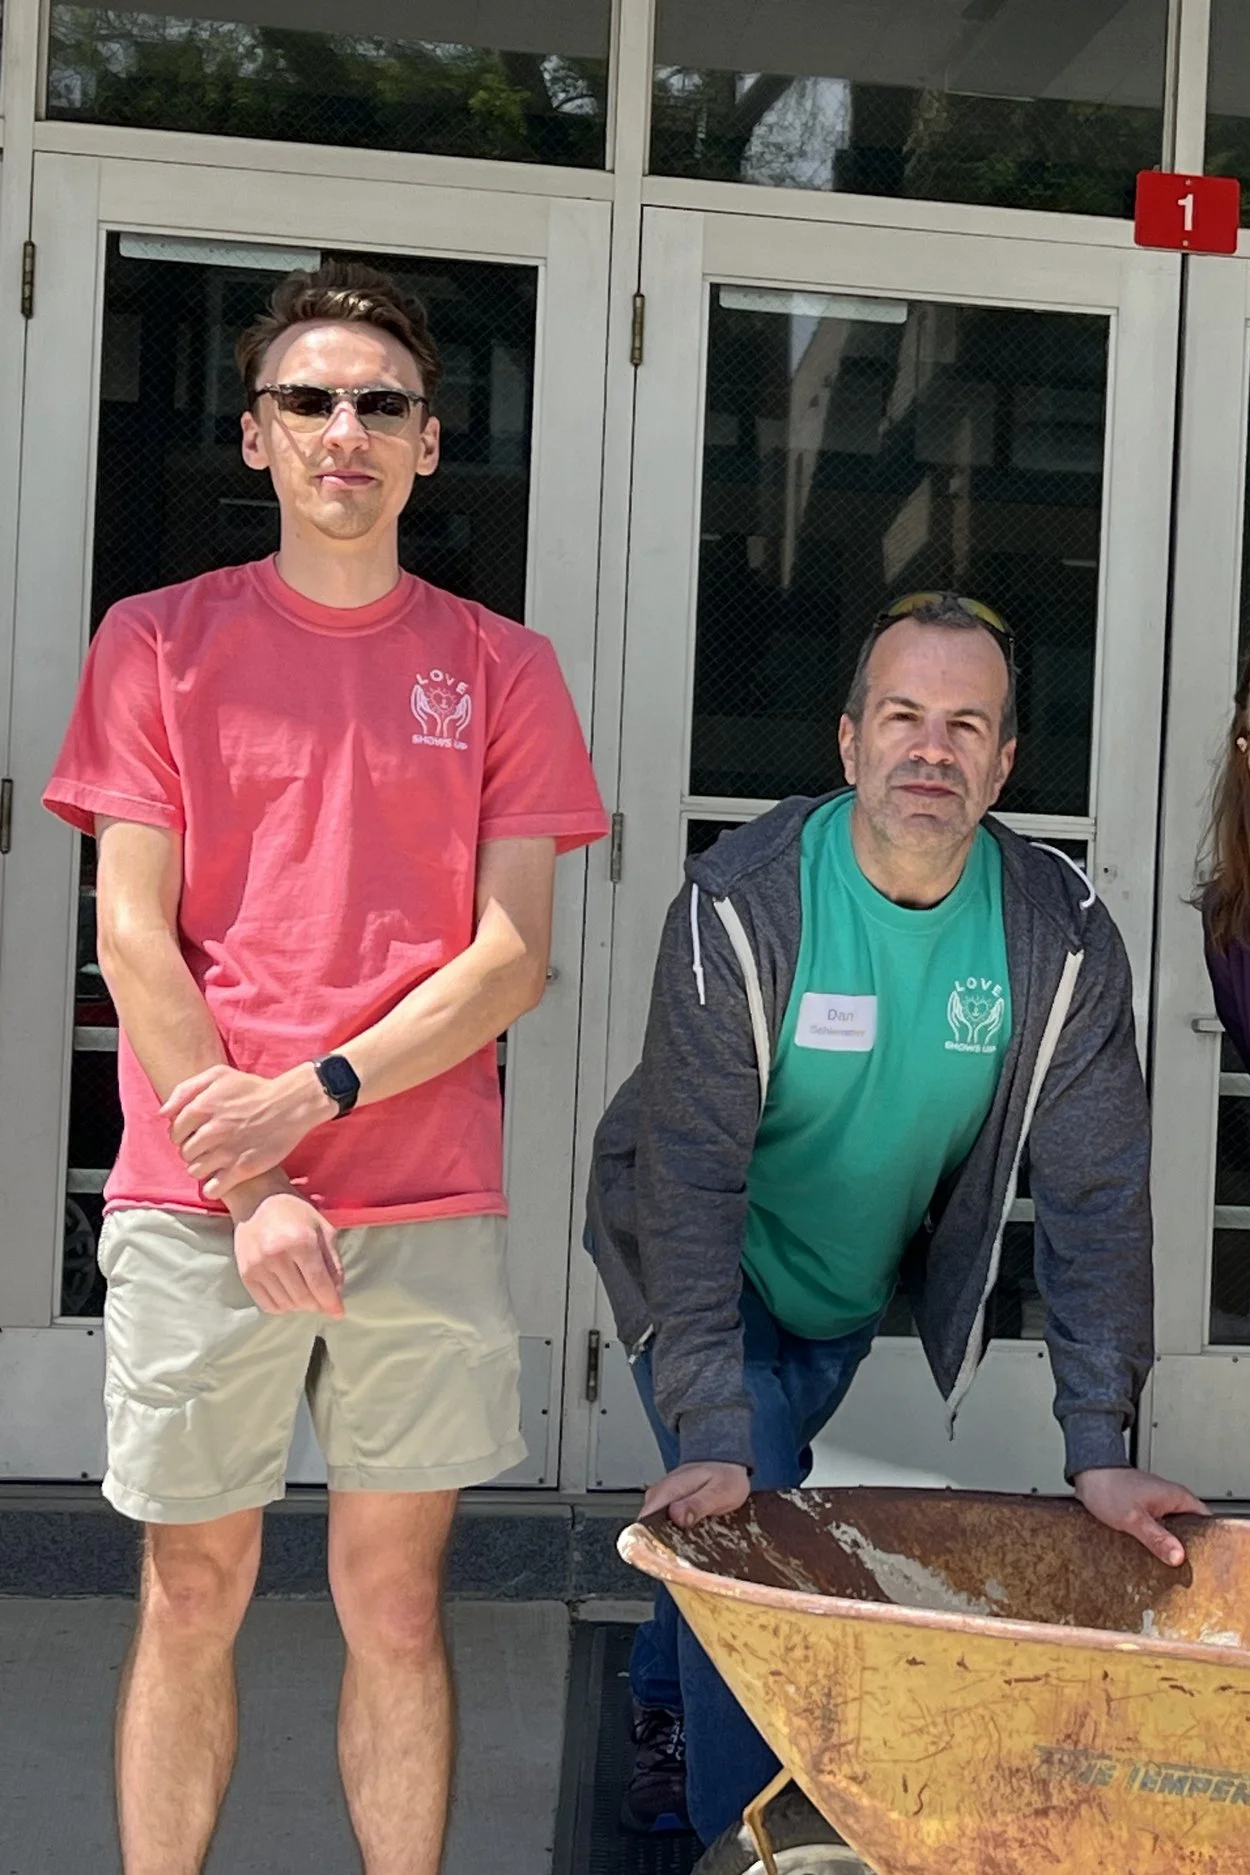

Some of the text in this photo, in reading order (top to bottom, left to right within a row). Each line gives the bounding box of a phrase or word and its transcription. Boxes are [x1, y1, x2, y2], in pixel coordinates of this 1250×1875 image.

[1178, 194, 1193, 231] 1
[416, 669, 469, 695] LOVE
[955, 976, 1002, 998] LOVE
